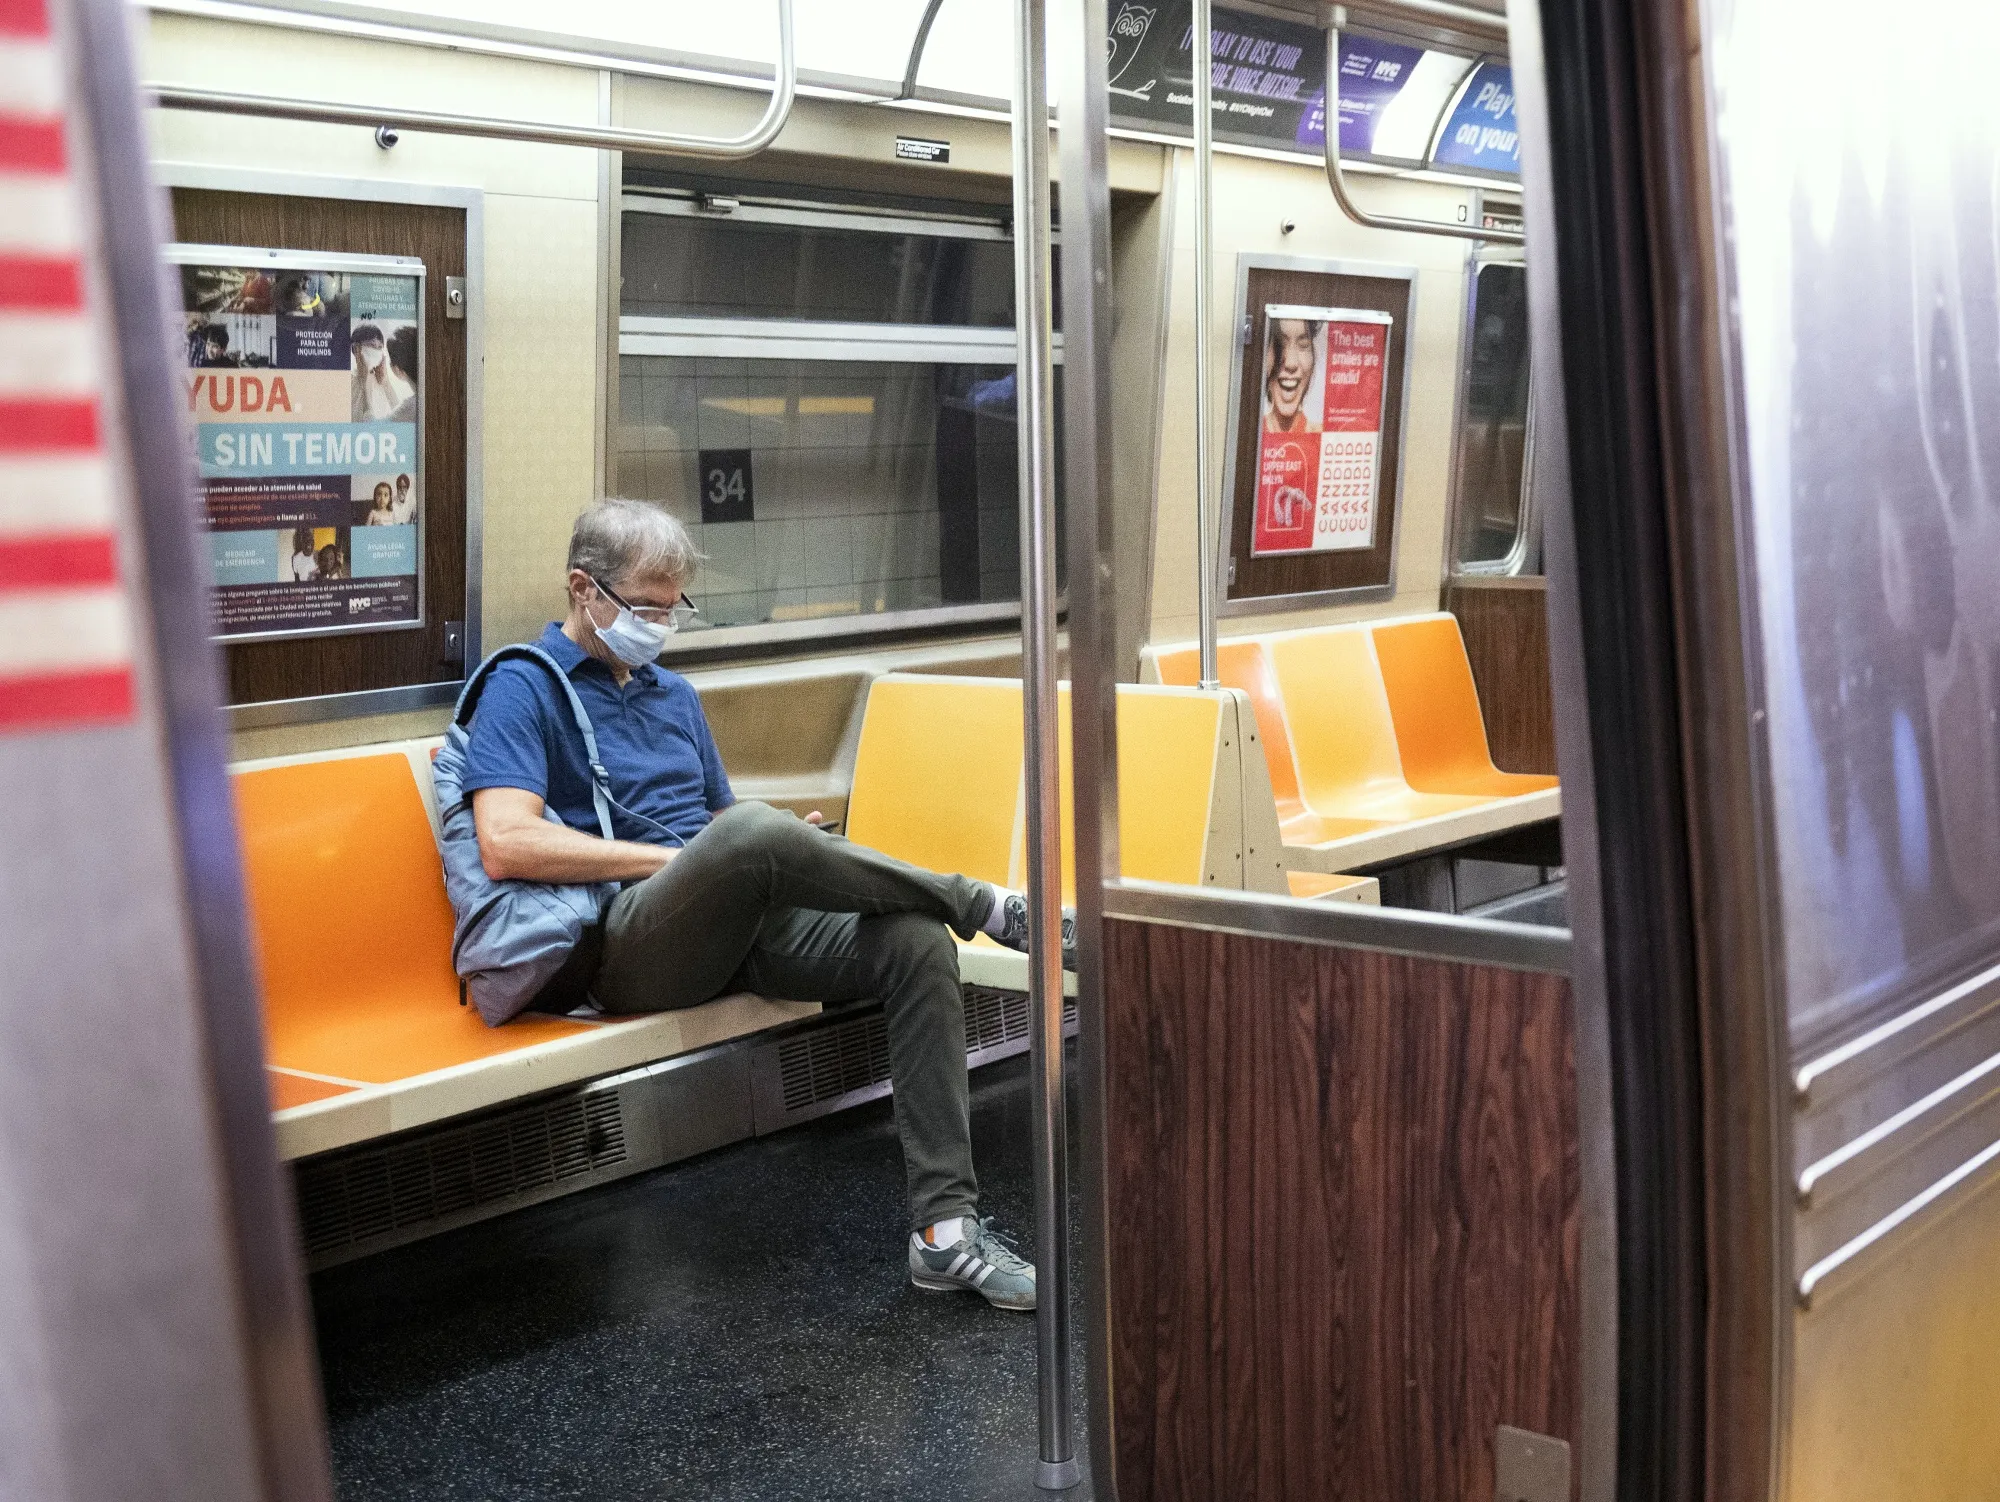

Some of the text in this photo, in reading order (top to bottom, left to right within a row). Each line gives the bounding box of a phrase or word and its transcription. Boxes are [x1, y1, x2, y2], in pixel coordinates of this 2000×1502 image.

[1233, 35, 1254, 61] TO
[1249, 39, 1276, 65] USE
[1270, 44, 1303, 71] YOUR
[1375, 60, 1402, 78] NYC
[1228, 66, 1264, 93] VOICE
[1472, 81, 1514, 120] Play
[1456, 123, 1480, 146] on
[1473, 126, 1518, 155] your
[361, 309, 377, 320] NO!
[295, 330, 333, 339] PROTECCIÓN
[1332, 329, 1375, 348] The best
[300, 339, 329, 348] PARA LOS
[297, 348, 332, 357] INQUILINOS
[1331, 350, 1379, 367] smiles are
[1330, 369, 1361, 385] candid
[215, 431, 406, 467] SIN TEMOR.
[1285, 460, 1302, 472] EAST
[209, 486, 233, 494] pueden
[233, 484, 258, 493] acceder
[270, 483, 296, 492] atención
[296, 483, 305, 491] de
[305, 482, 322, 491] salud
[708, 467, 746, 505] 34
[281, 513, 298, 521] llama
[298, 513, 305, 521] al
[349, 597, 371, 608] NYC
